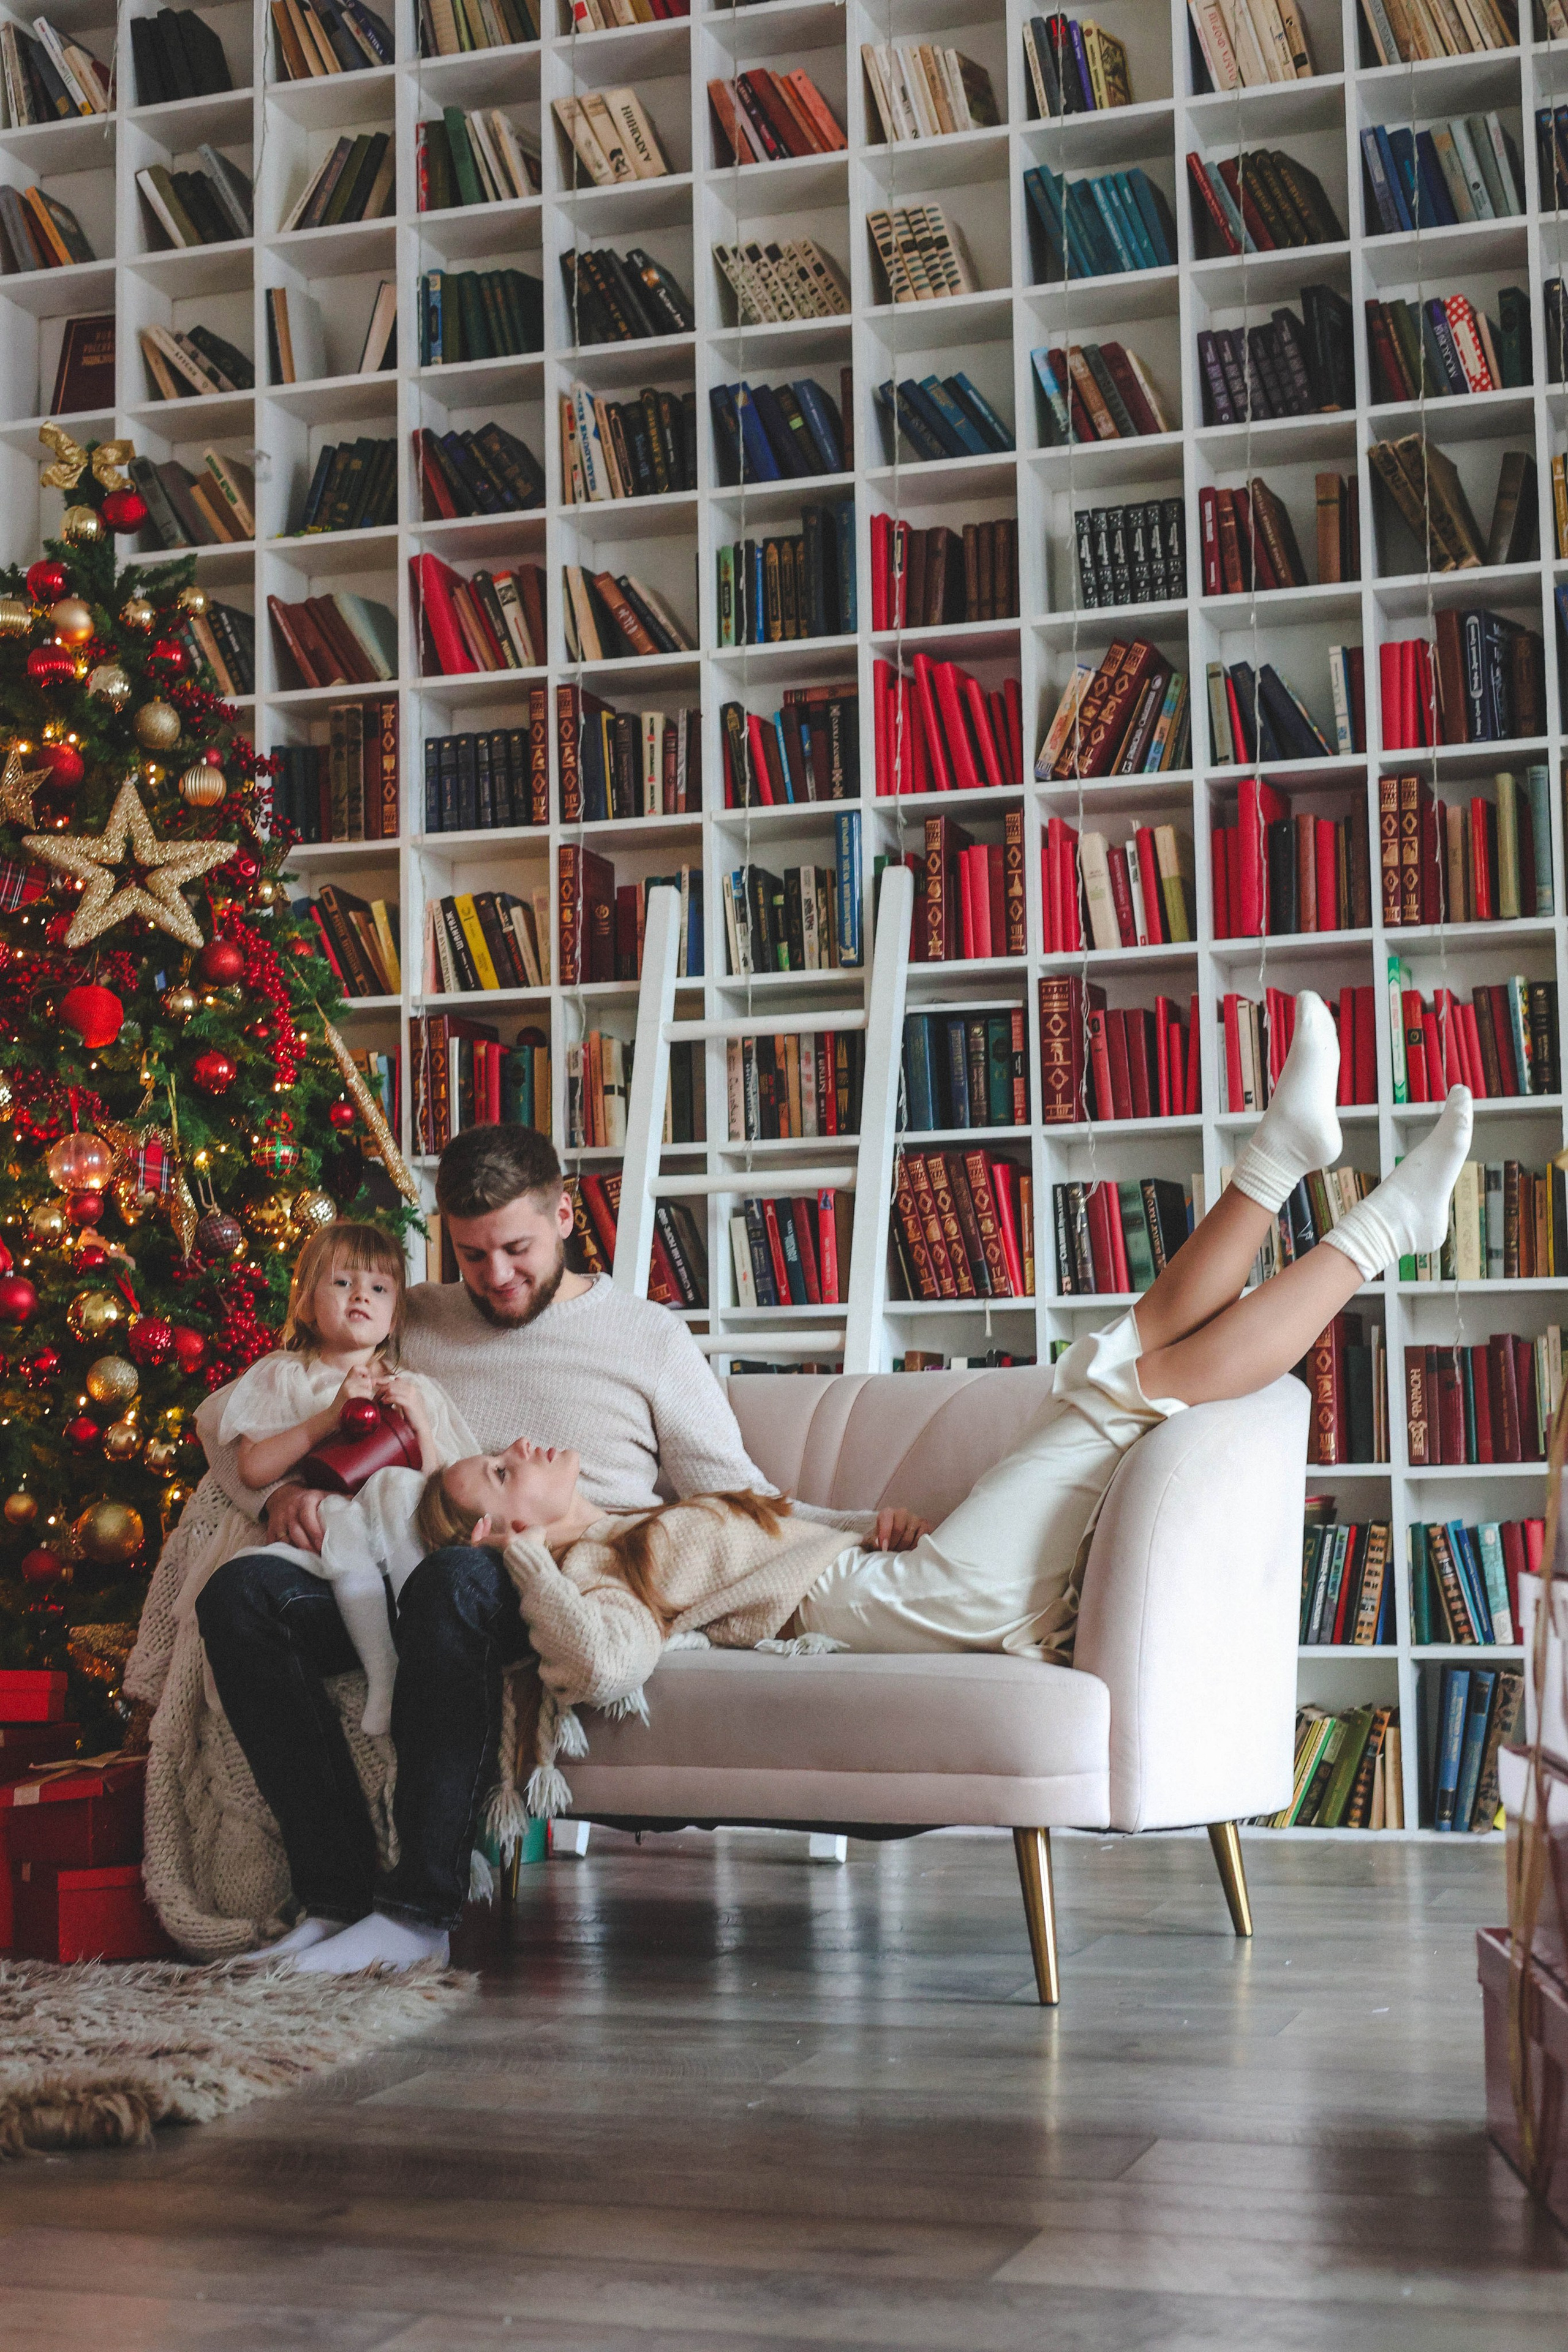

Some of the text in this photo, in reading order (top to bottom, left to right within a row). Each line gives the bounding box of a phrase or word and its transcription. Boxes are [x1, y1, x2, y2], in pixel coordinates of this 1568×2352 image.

[1208, 11, 1226, 50] ФОРШ
[446, 911, 464, 951] ШАНТАЖ
[1410, 1368, 1423, 1418] ФАРАОН
